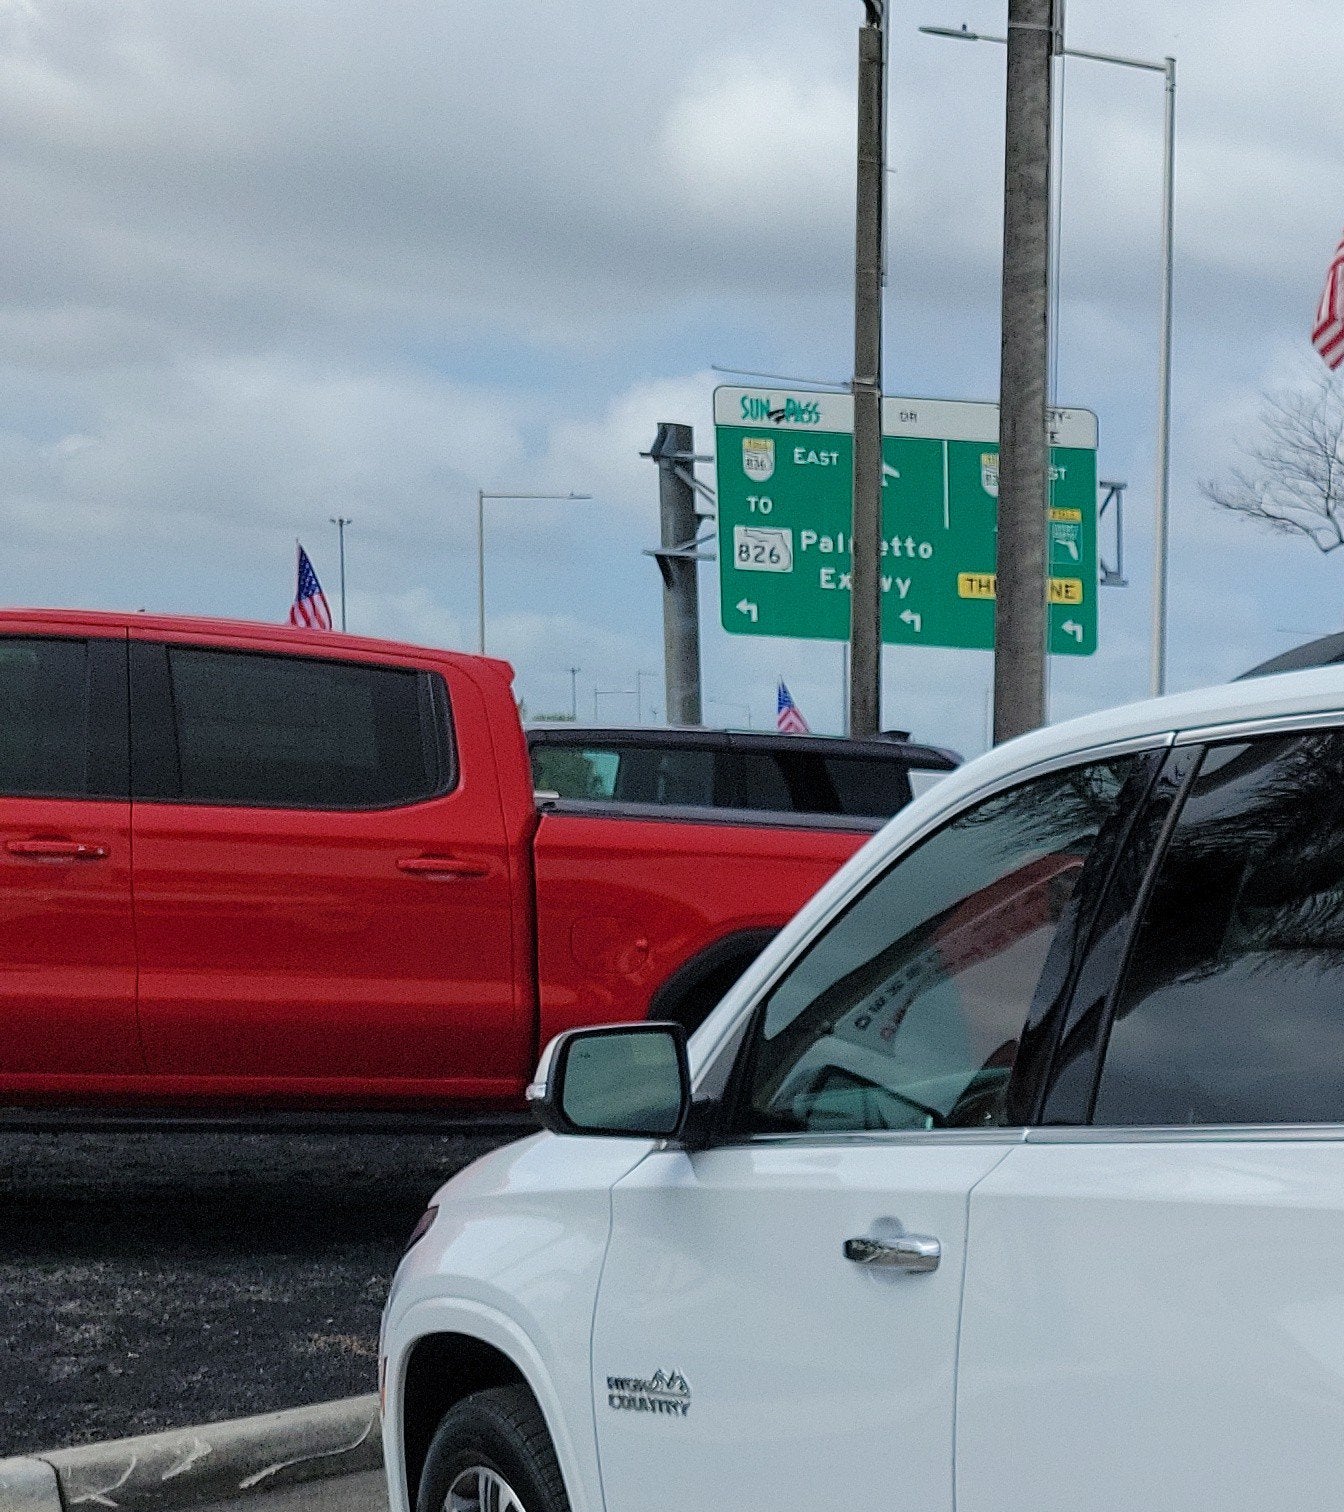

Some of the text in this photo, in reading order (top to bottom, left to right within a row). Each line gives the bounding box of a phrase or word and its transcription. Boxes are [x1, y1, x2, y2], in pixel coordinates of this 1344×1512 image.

[793, 447, 839, 466] EAST
[746, 496, 773, 515] TO
[737, 543, 781, 565] 826
[801, 528, 933, 559] Paletto
[819, 566, 912, 599] Exwy
